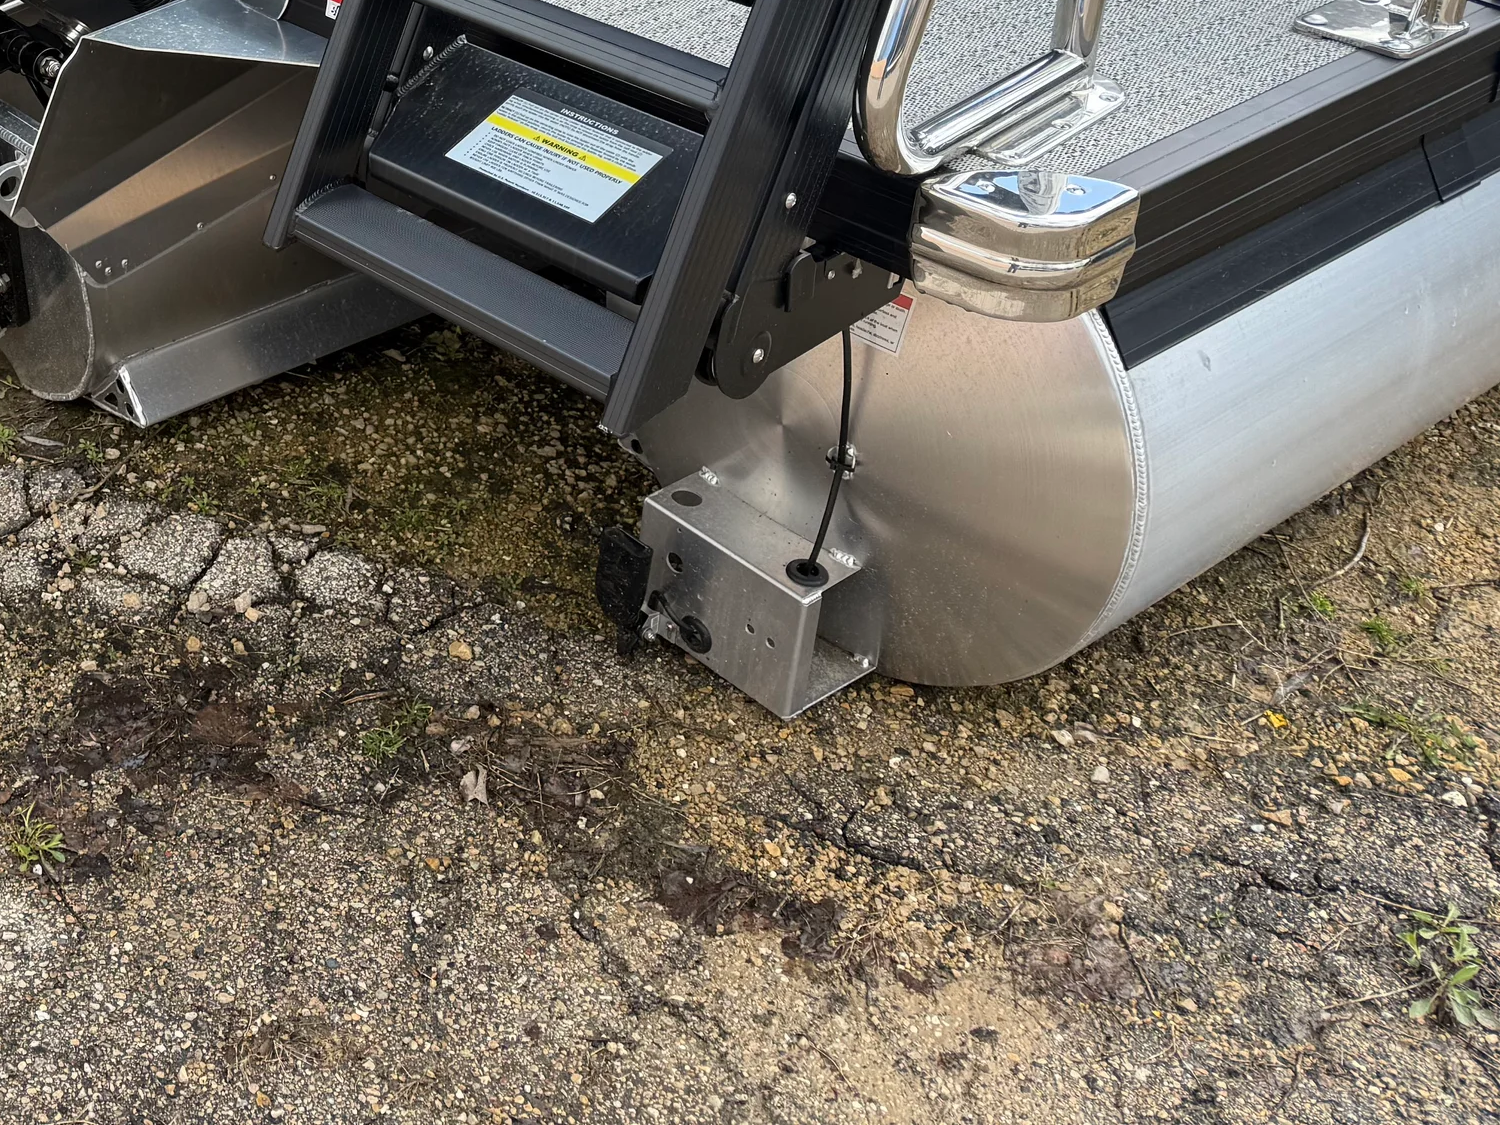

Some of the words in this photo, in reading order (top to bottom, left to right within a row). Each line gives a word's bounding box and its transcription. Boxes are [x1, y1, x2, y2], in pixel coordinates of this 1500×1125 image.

[560, 107, 620, 136] INSTRUCTIONS
[491, 126, 515, 138] LADDERS
[525, 141, 543, 150] CAUSE
[542, 148, 562, 158] INJURY
[566, 158, 579, 166] NOT
[578, 164, 594, 172] USED
[593, 170, 622, 184] PROPERLY
[541, 138, 579, 158] WARNING
